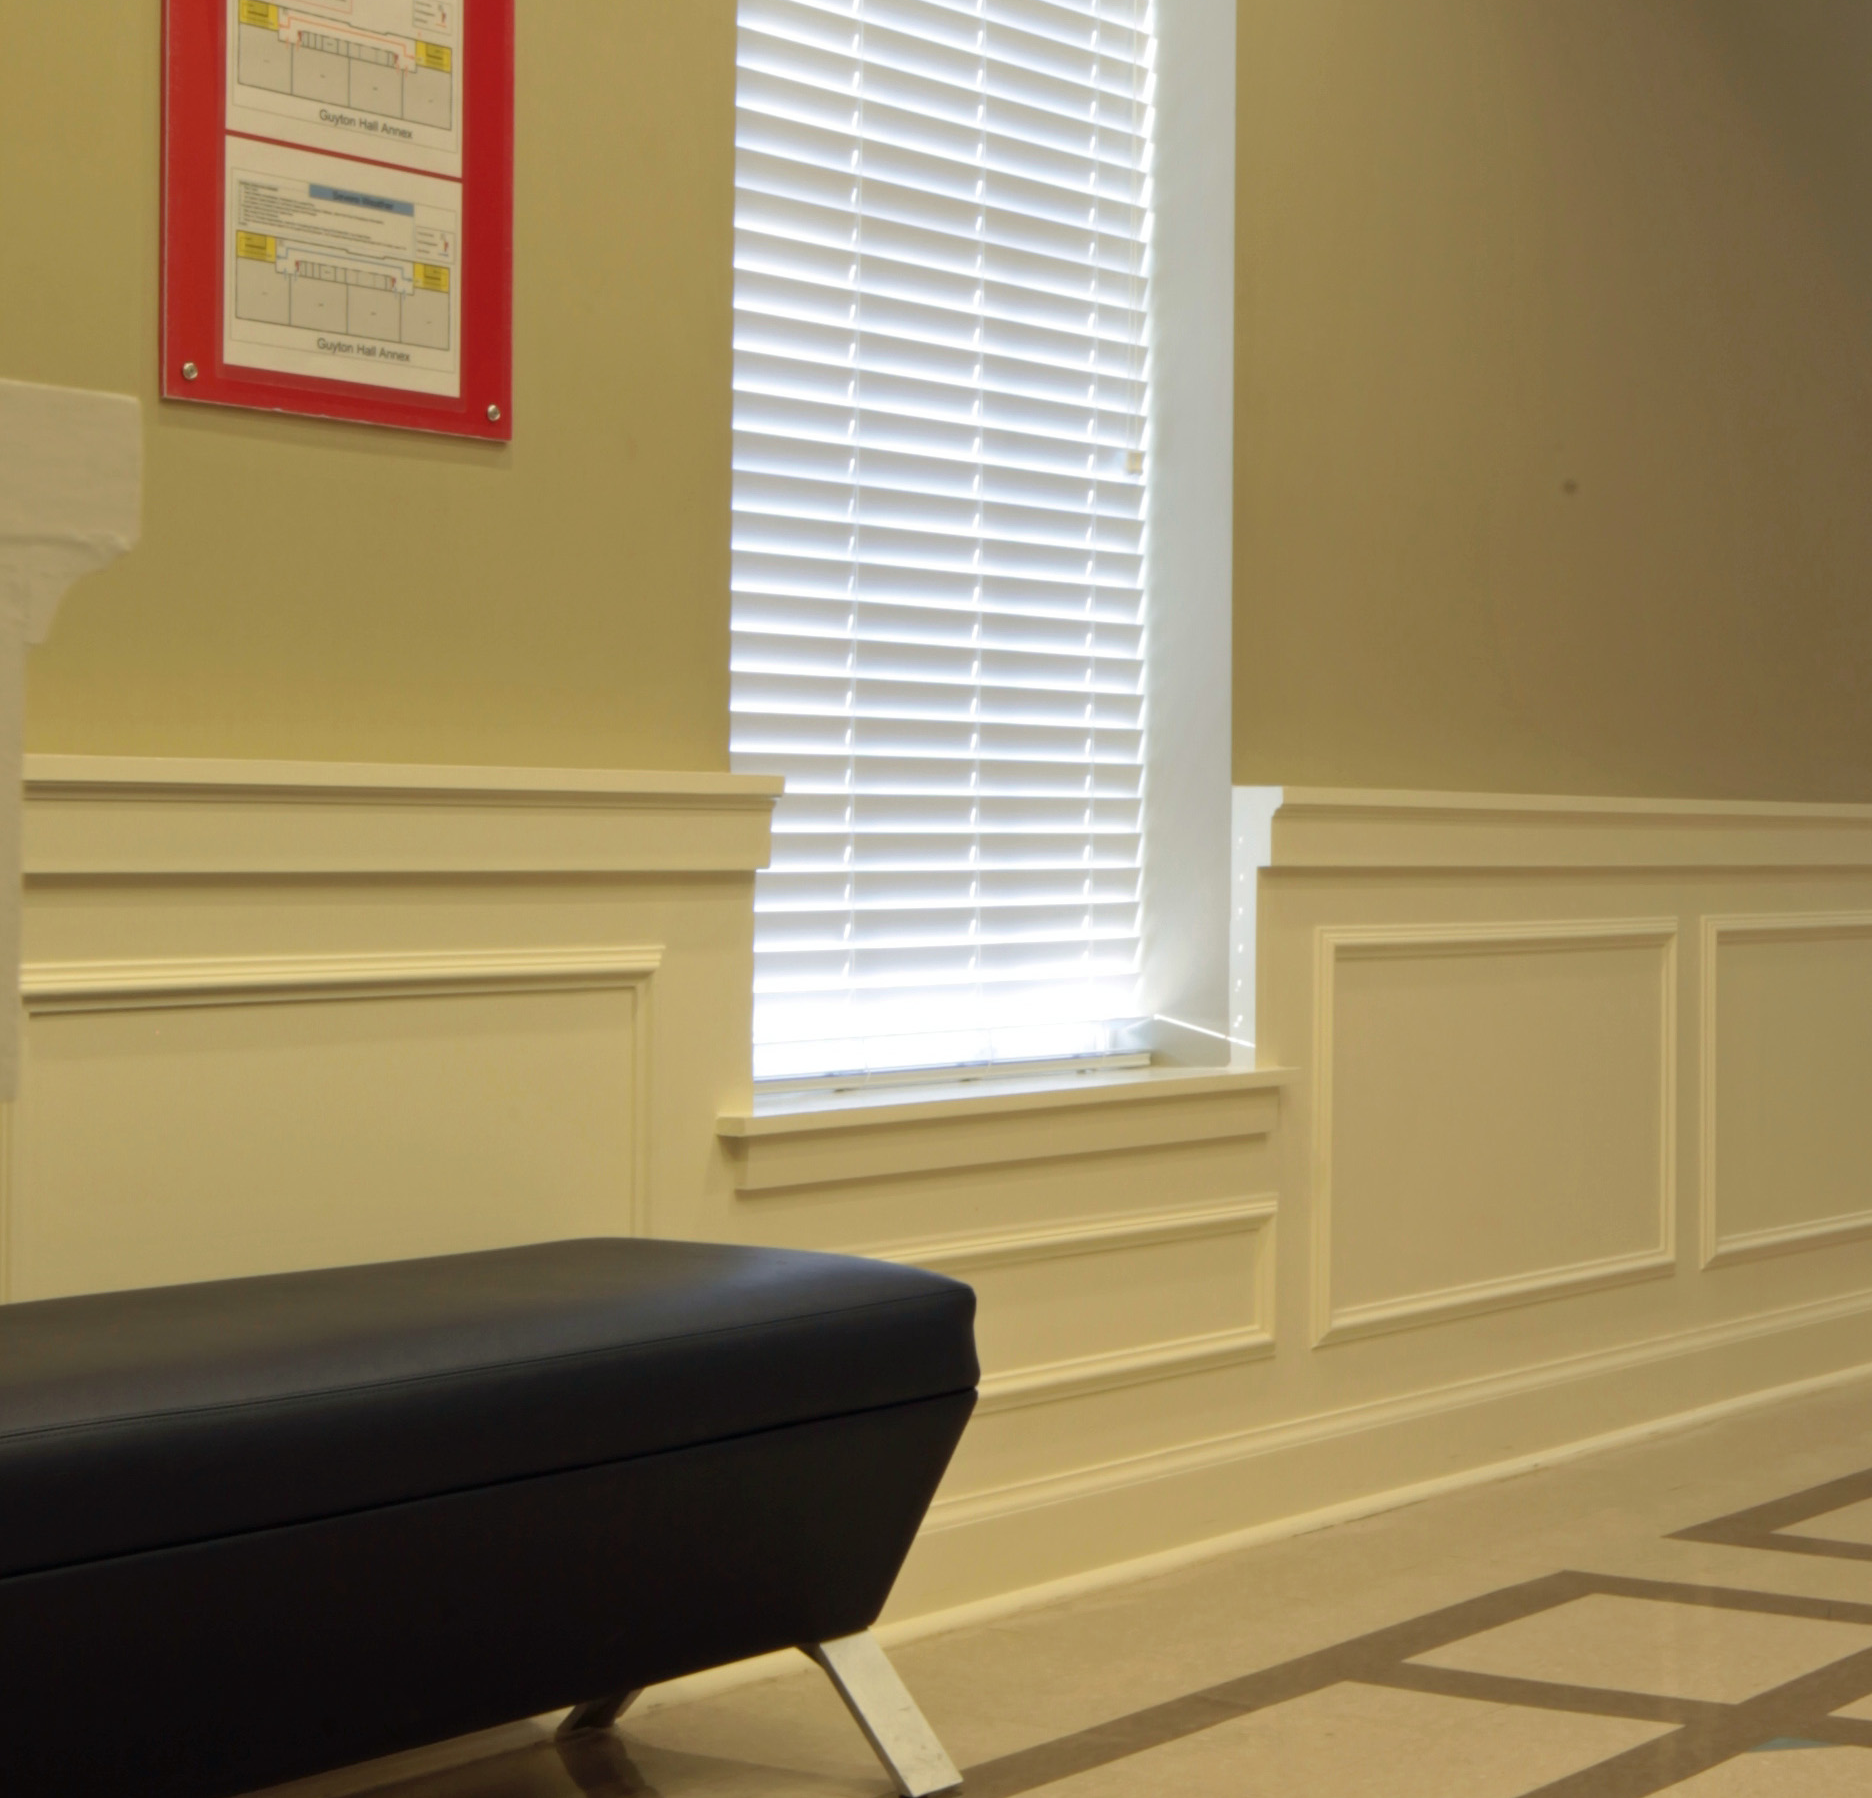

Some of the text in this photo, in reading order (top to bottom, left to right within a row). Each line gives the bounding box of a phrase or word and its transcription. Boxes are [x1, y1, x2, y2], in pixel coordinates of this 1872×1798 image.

[319, 108, 414, 139] Guyton Hall Annex
[316, 337, 410, 362] Guyton Hall Annex
